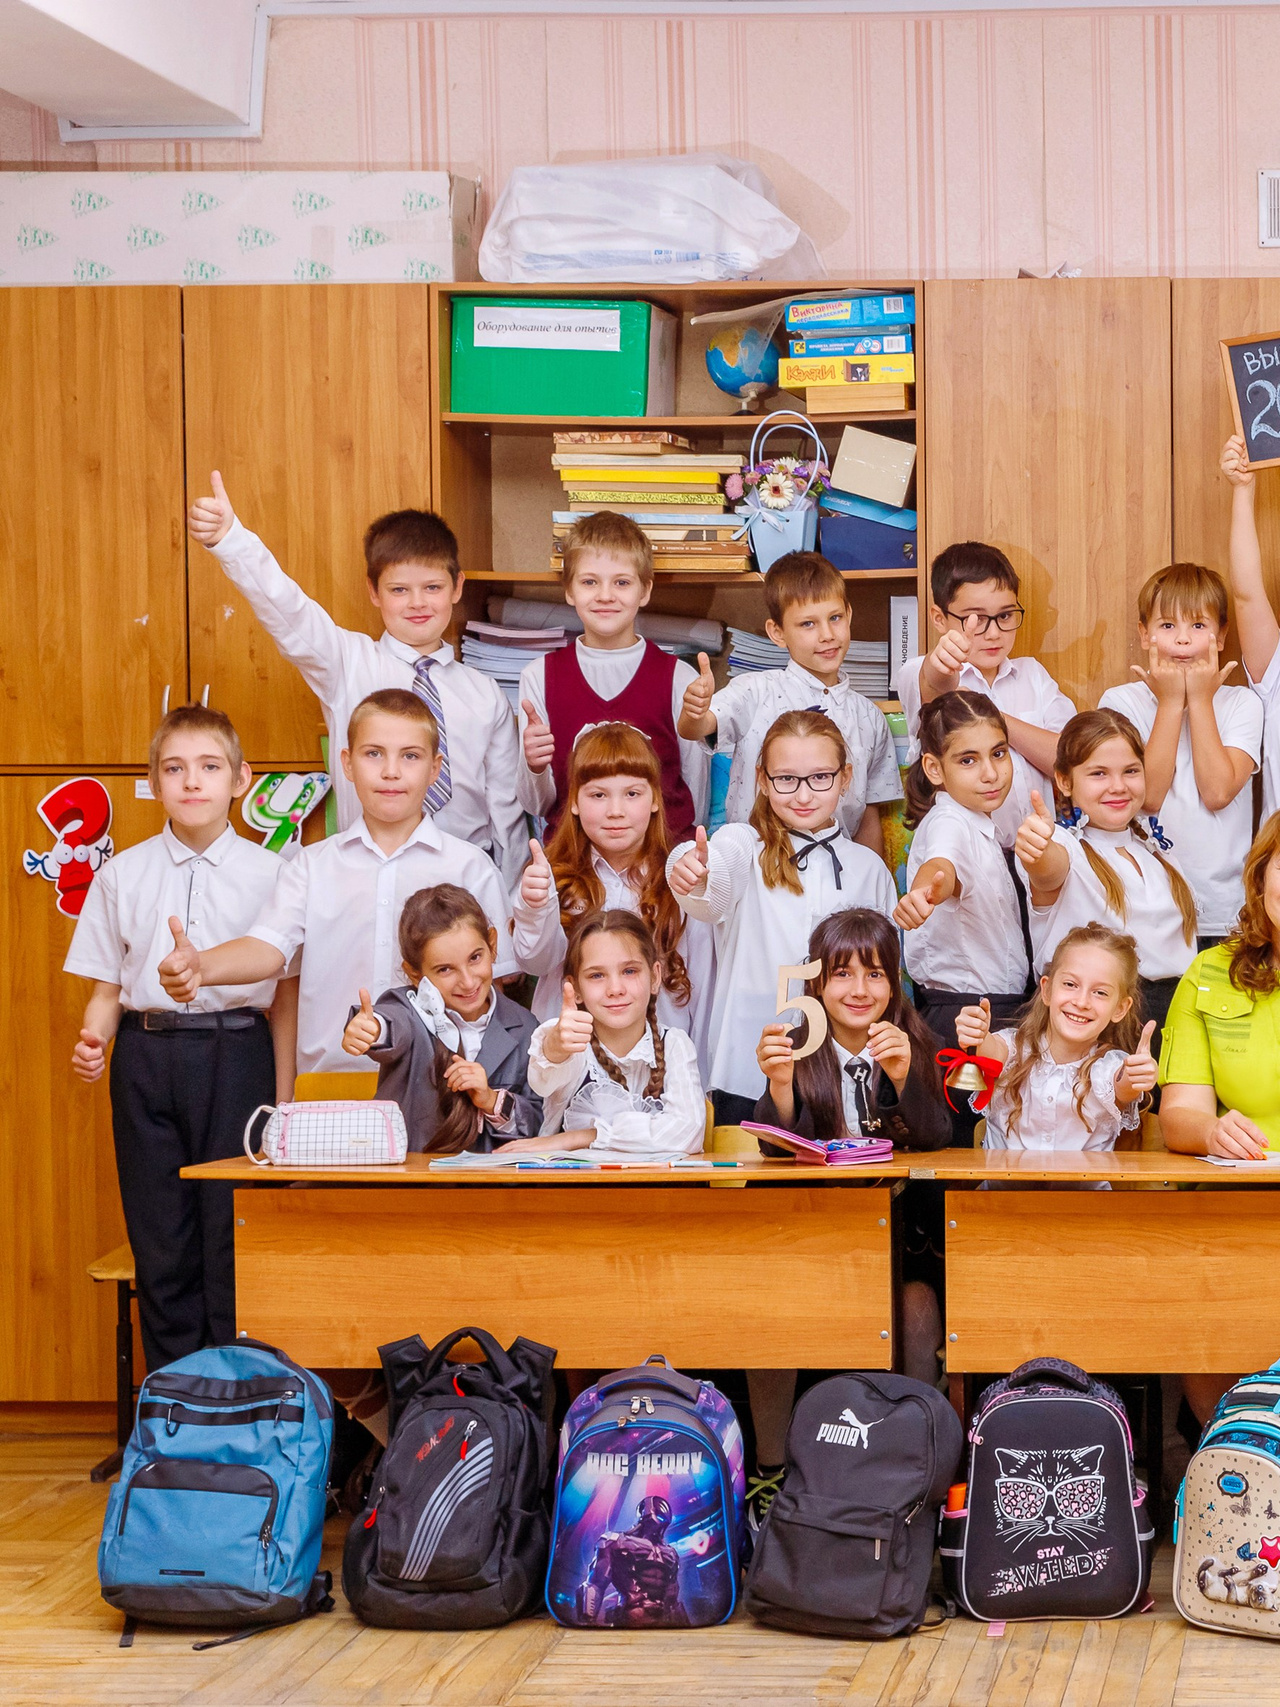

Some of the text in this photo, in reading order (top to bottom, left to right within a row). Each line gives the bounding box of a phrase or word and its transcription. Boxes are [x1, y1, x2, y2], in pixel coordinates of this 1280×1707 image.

[477, 321, 552, 334] Оборудование
[554, 322, 572, 333] для
[776, 958, 828, 1061] 5
[816, 1423, 860, 1447] PUMA
[636, 1451, 703, 1476] BERRY
[1036, 1545, 1065, 1559] STAY
[1015, 1554, 1094, 1588] WILD
